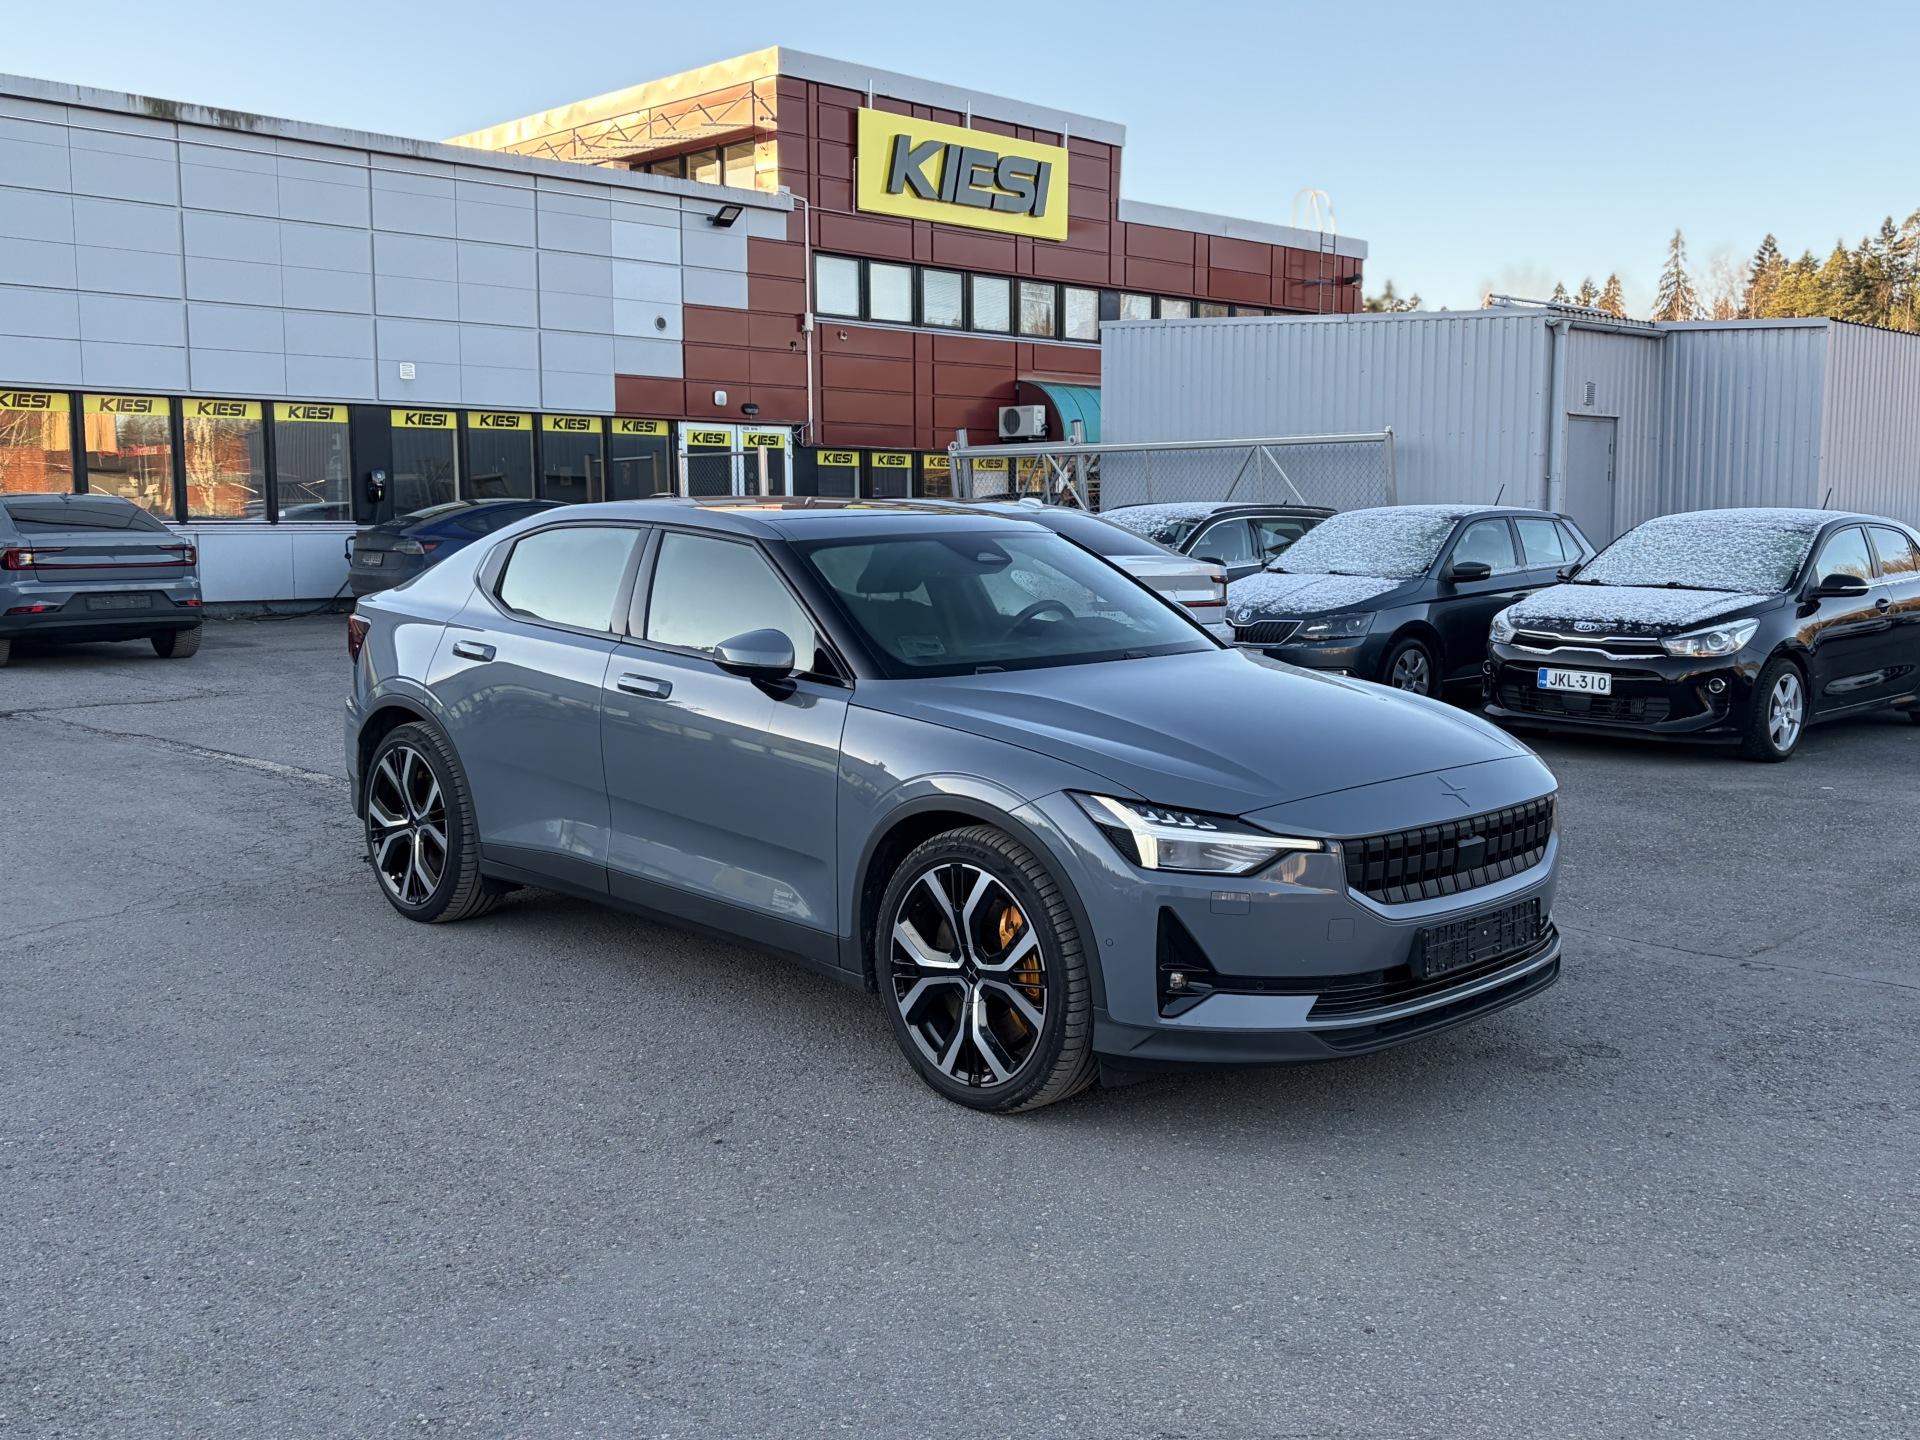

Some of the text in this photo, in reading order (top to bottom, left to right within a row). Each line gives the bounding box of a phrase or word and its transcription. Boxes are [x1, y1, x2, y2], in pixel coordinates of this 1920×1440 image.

[886, 133, 1053, 218] KIESI
[99, 398, 153, 412] KIESI
[197, 401, 247, 417] KIESI
[288, 405, 334, 420] KIESI
[405, 412, 447, 426] KIESI
[479, 414, 520, 428] KIESI
[553, 417, 590, 431] KIESI
[621, 420, 657, 433] KIESI
[692, 432, 726, 444] KIESI
[747, 434, 779, 446] KIESI
[823, 452, 853, 464] KIESI
[877, 454, 906, 466] KIESI
[929, 456, 950, 467] KIES
[978, 459, 1003, 469] KIESI
[1549, 672, 1607, 690] JKL-310
